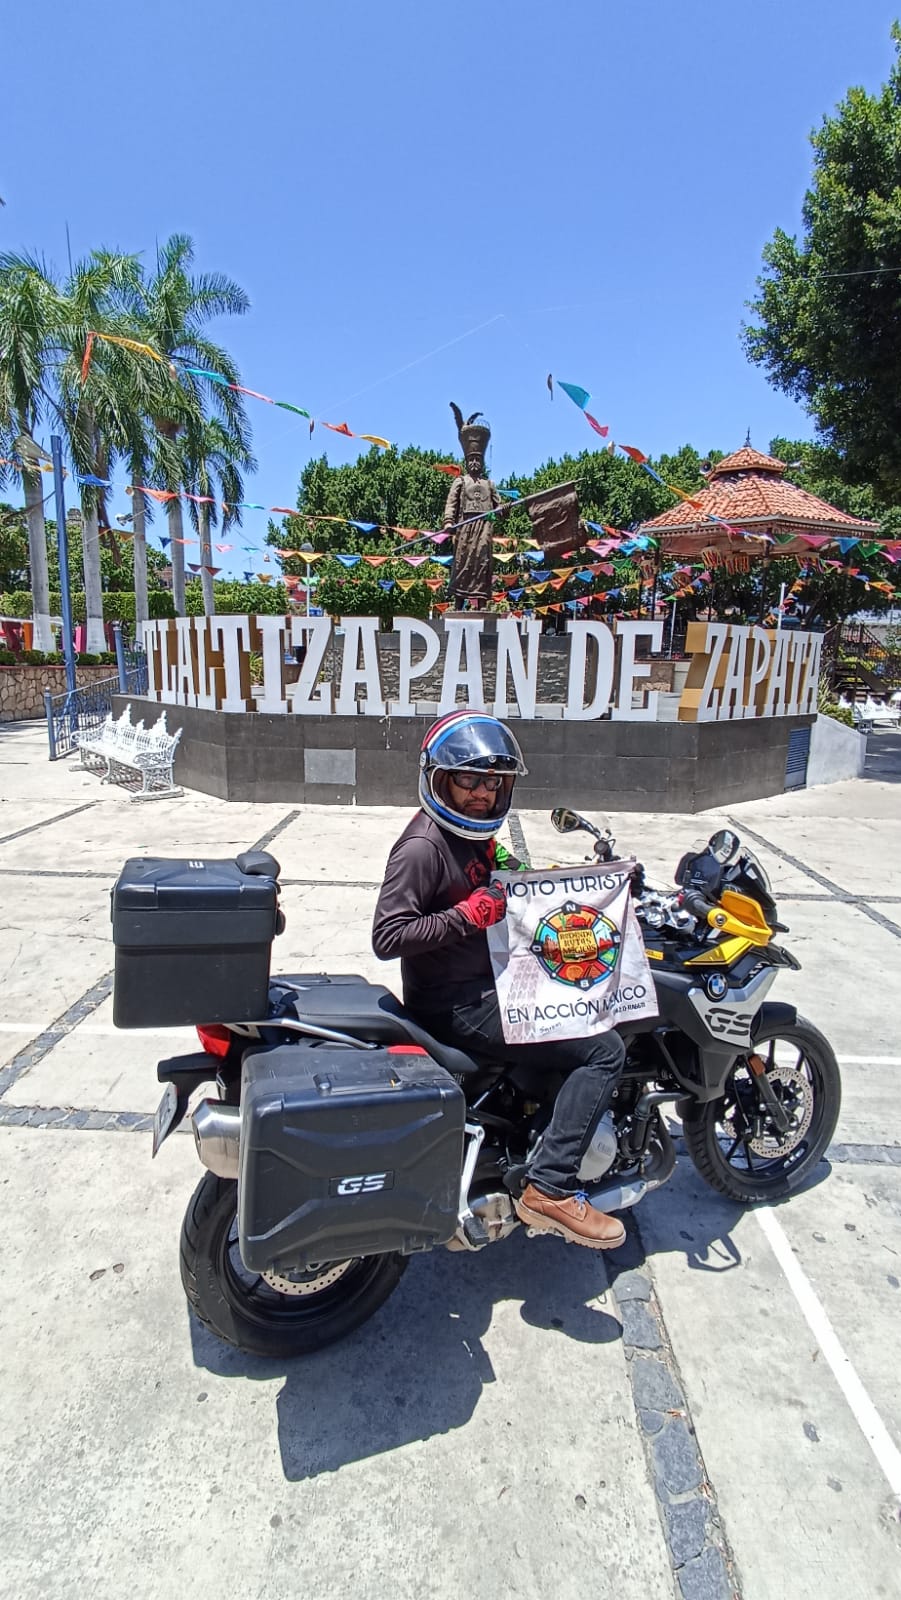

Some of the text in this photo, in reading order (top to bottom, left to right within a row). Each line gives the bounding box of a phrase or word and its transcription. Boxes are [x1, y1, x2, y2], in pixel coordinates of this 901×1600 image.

[142, 615, 825, 721] TLALTIZAPAN DE ZAPATA
[559, 873, 625, 894] TURIST
[507, 1007, 530, 1024] EN
[534, 997, 600, 1020] ACCIÓN
[705, 1007, 754, 1036] GS
[337, 1174, 386, 1195] GS
